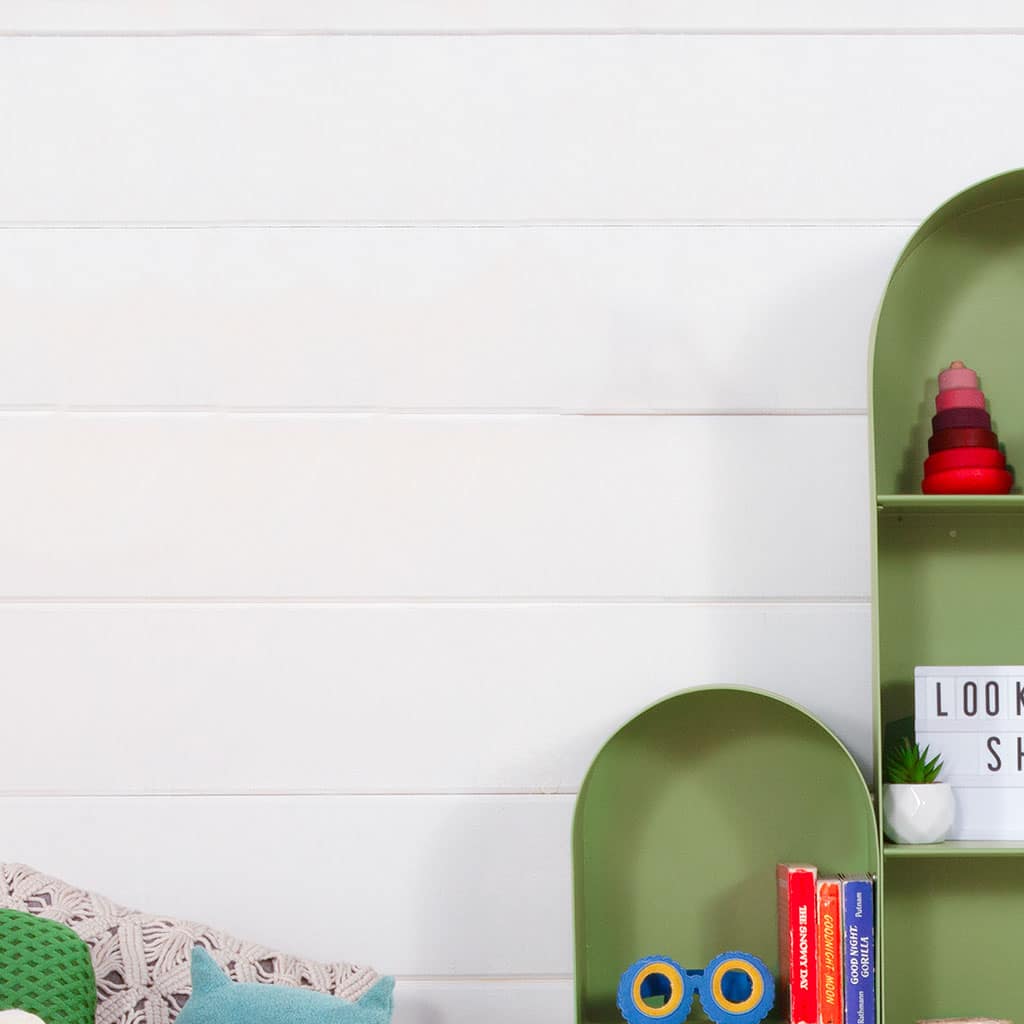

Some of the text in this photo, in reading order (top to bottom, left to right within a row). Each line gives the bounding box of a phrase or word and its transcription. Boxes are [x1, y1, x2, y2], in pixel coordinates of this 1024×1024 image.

[854, 892, 862, 917] Putnam
[798, 904, 808, 990] THE SNOWY DAY
[823, 914, 835, 1004] GOODNIGHT MOON
[858, 936, 870, 977] GORILLA
[849, 959, 859, 984] GOOD
[856, 990, 865, 1024] Rathmann
